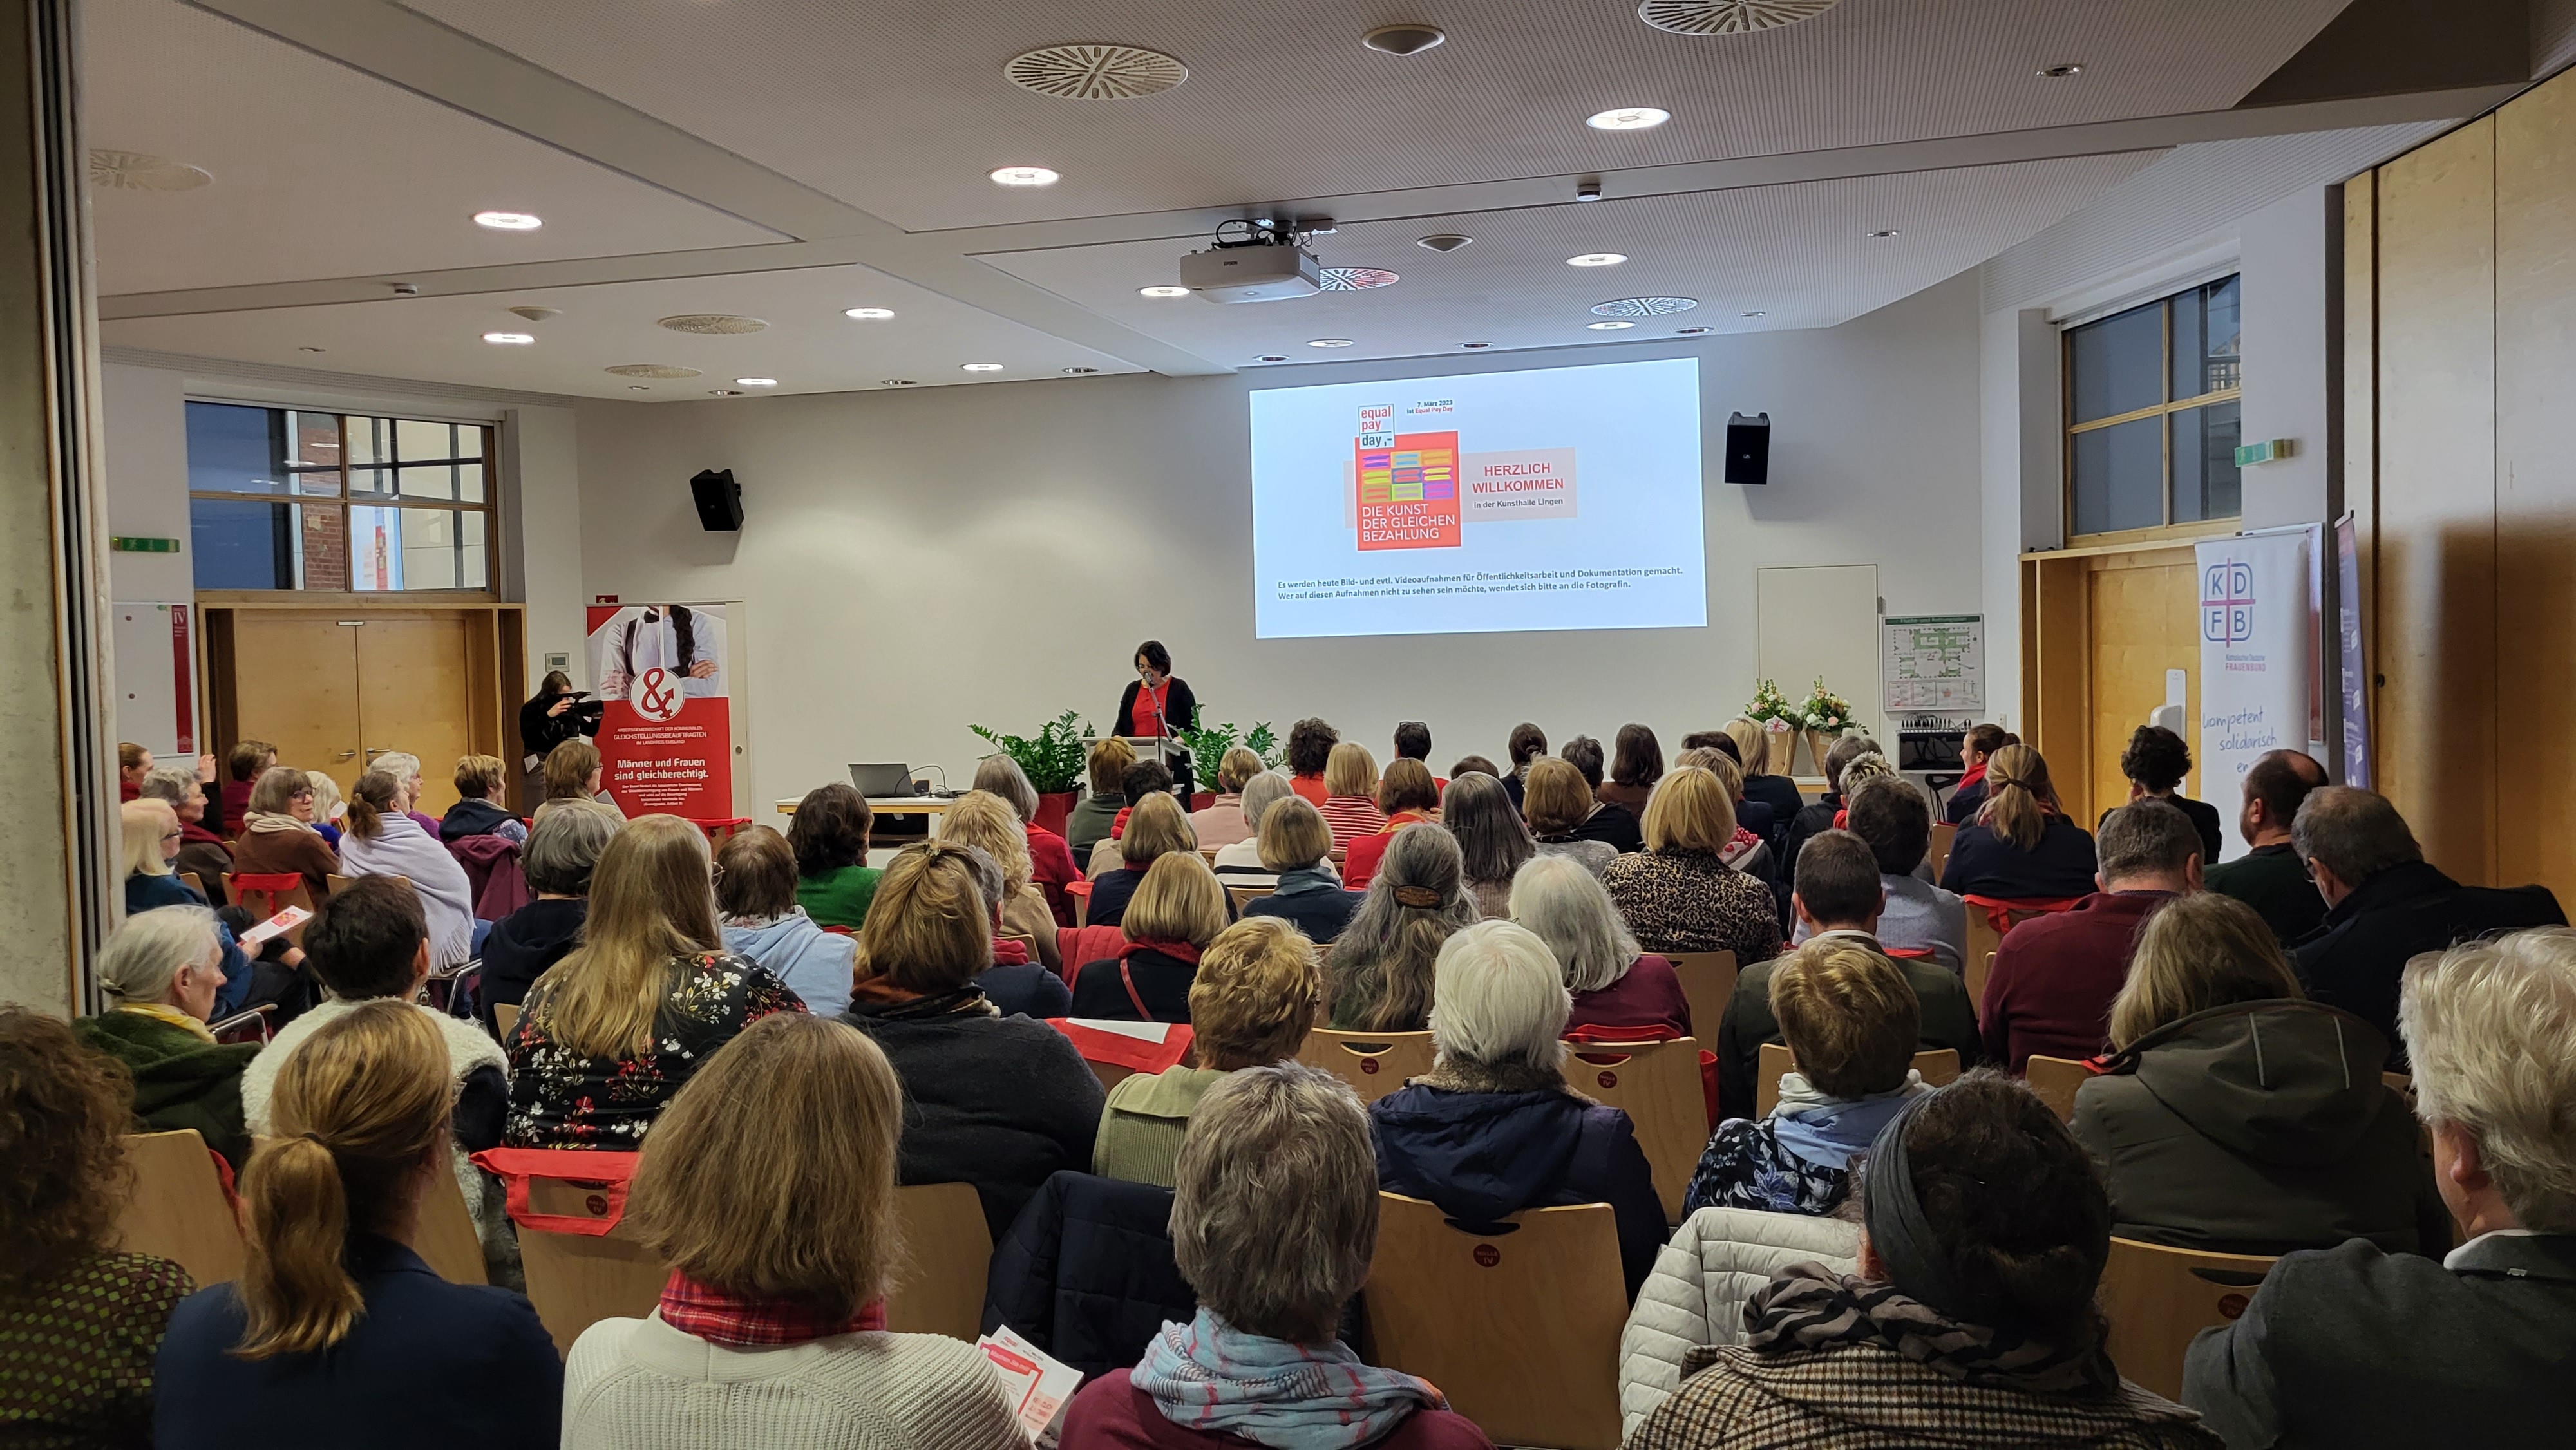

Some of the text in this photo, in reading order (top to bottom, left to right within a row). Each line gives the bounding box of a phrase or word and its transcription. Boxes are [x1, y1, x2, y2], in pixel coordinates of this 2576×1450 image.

[1361, 406, 1391, 420] equal
[1361, 420, 1381, 432] pay
[1484, 462, 1551, 476] HERZLICH
[1472, 478, 1564, 493] WILLKOMMEN
[1497, 499, 1535, 507] Kunsthalle
[1362, 504, 1428, 518] DIE KUNST
[1363, 515, 1455, 529] DER GLEICHEN
[1363, 528, 1439, 541] BEZAHLUNG
[1394, 575, 1461, 583] Videoaufnahmen
[1476, 570, 1557, 581] Öffentlichkeitsarbeit
[1578, 568, 1642, 577] Dokumentation
[1643, 567, 1683, 576] gemacht.
[1335, 589, 1379, 598] Aufnahmen
[1455, 585, 1486, 594] möchte,
[1489, 583, 1519, 592] wendet
[1586, 580, 1631, 590] Fotografin.
[2212, 572, 2246, 595] K D
[2211, 610, 2246, 633] F B
[2203, 705, 2263, 733] kompetent
[613, 731, 707, 740] GLEICHSTELLUNGSBEAUFTRAGTEN
[2219, 727, 2277, 751] solidarisch
[617, 758, 705, 769] Männer und Frauen
[614, 769, 709, 780] sind gleichberechtigt.
